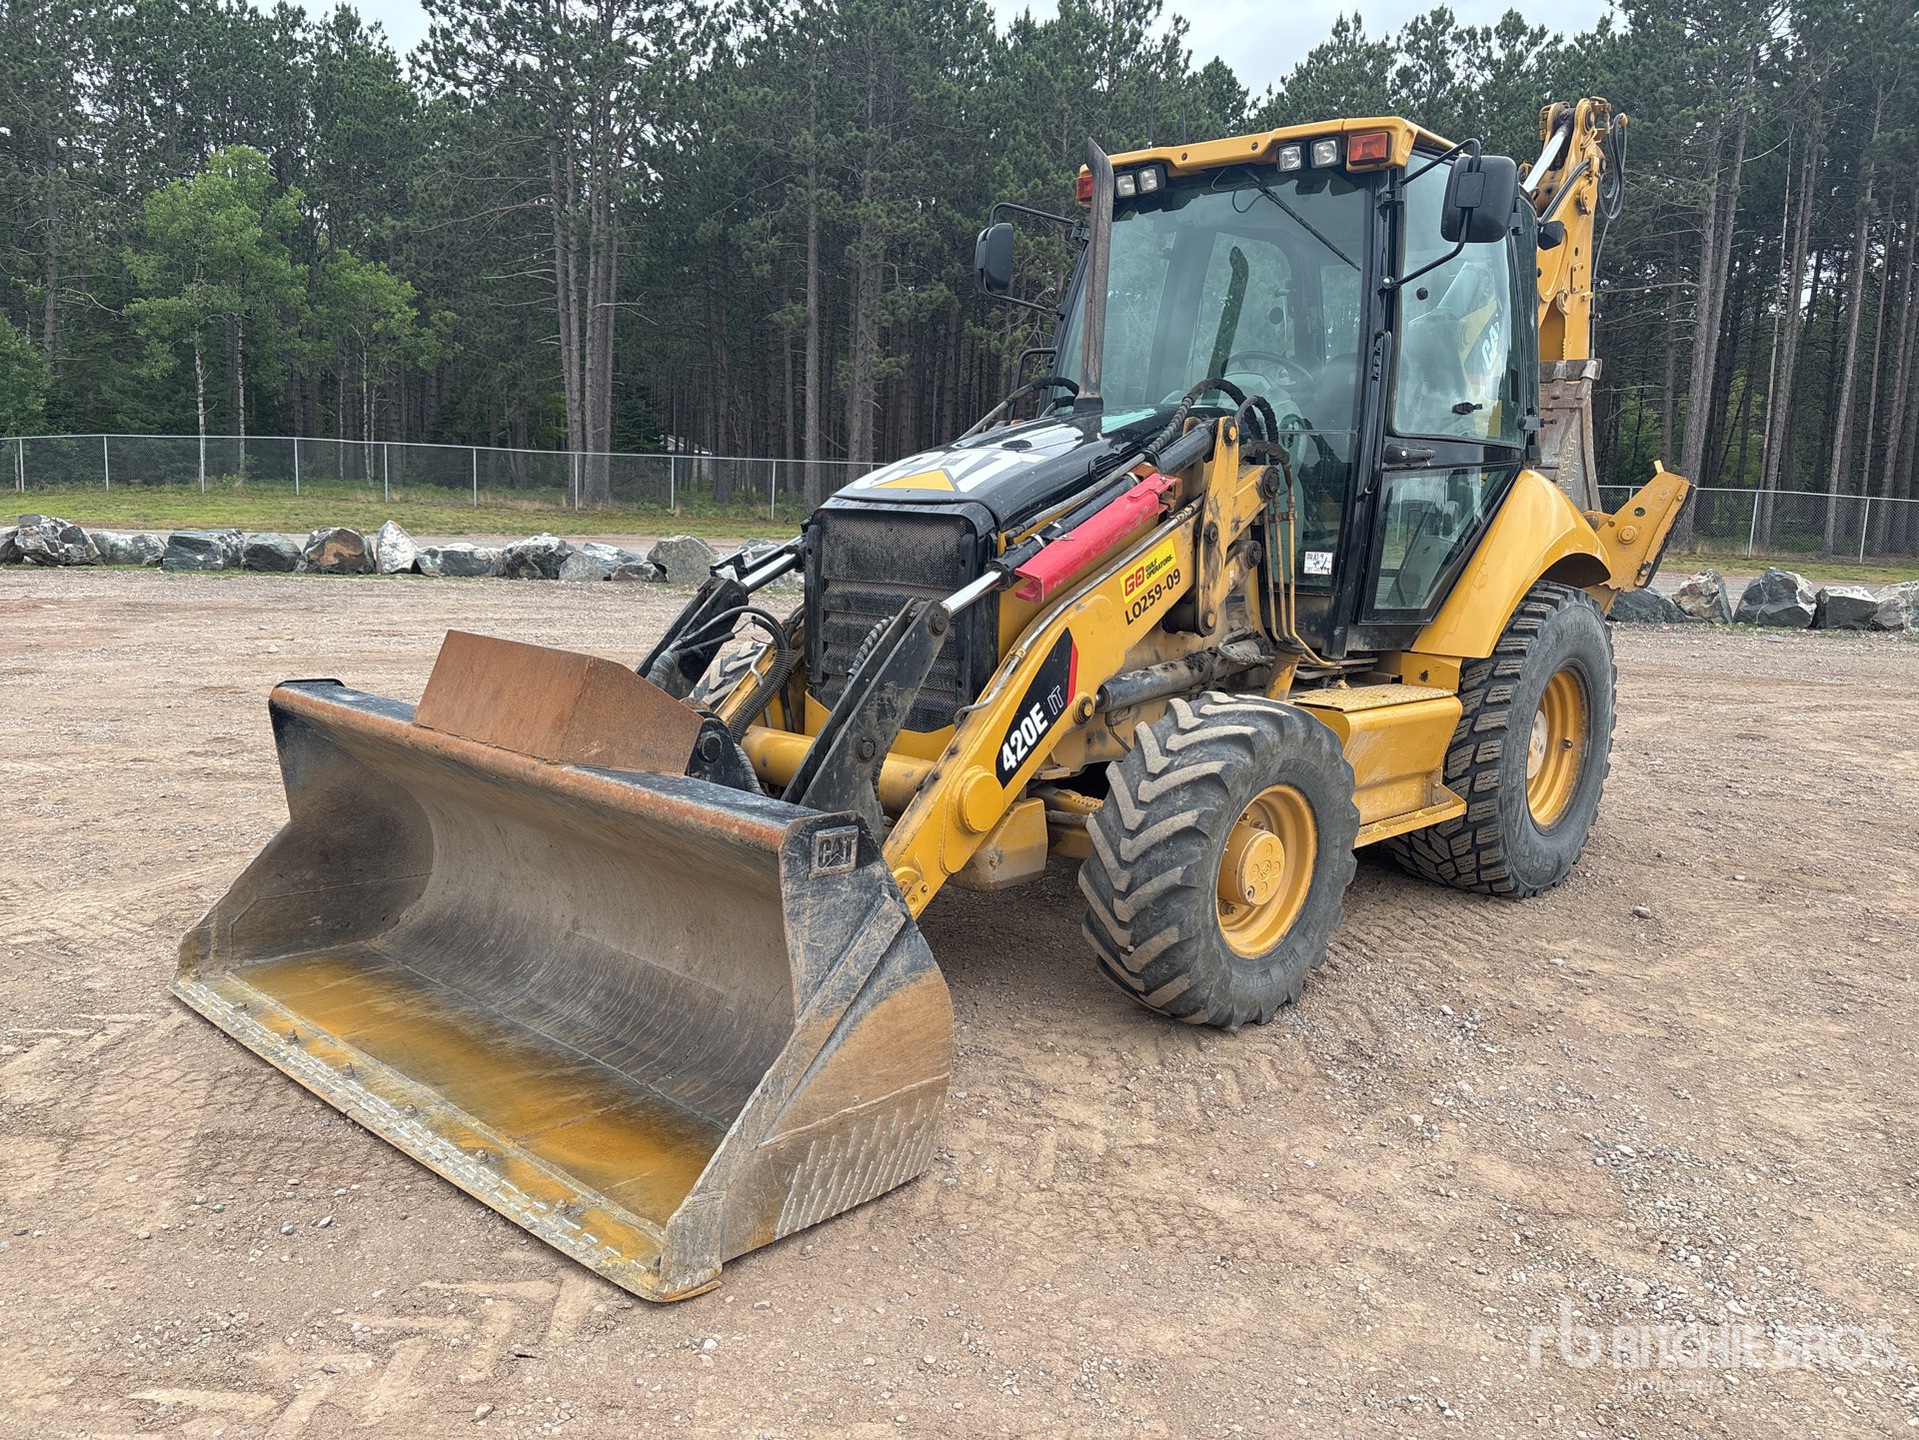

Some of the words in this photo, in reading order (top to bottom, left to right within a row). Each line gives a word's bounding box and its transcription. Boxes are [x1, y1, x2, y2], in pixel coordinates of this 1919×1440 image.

[1145, 557, 1157, 572] GULF
[1125, 566, 1145, 597] GO
[1002, 702, 1048, 771] 420E
[1047, 685, 1064, 715] IT
[818, 834, 855, 868] CAT
